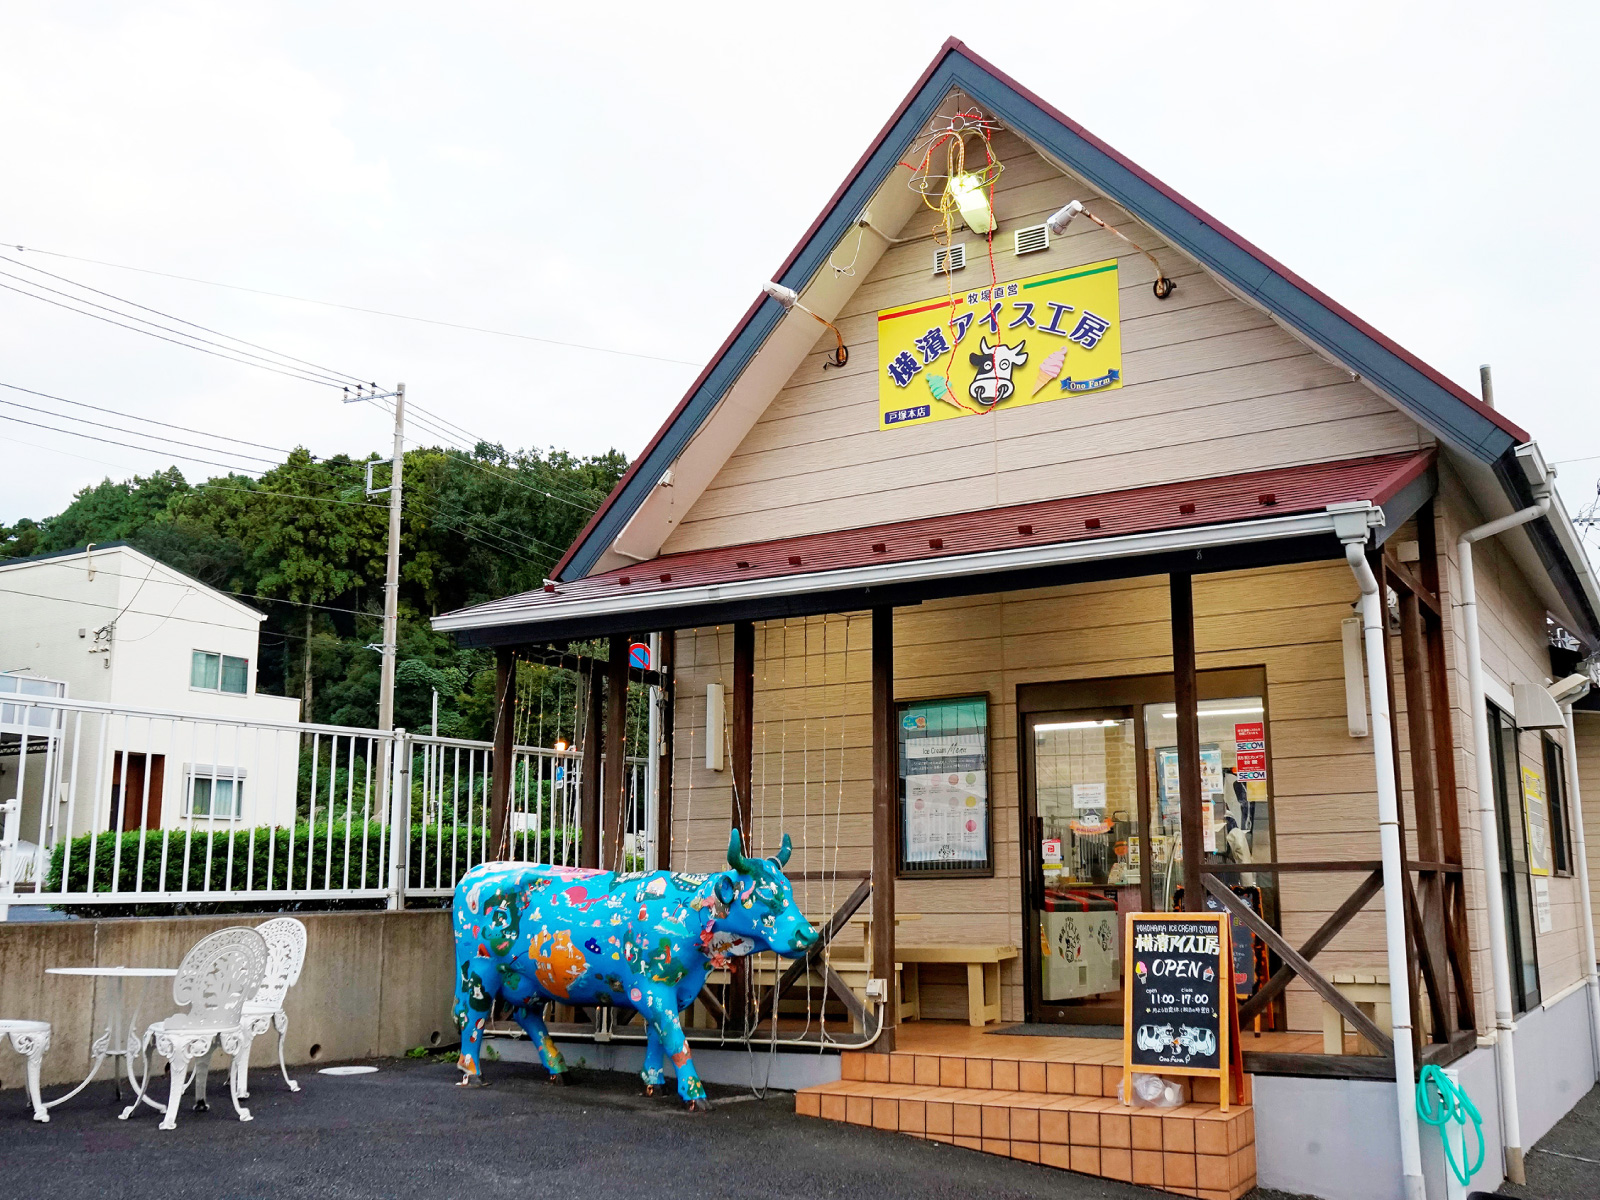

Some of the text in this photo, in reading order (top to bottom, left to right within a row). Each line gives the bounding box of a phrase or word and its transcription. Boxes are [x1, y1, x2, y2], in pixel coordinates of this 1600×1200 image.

[967, 284, 1018, 305] 牧場直営
[887, 302, 1111, 388] 横濱アイス工房
[1089, 377, 1110, 388] Farm
[888, 406, 926, 422] 戸塚本店
[1237, 742, 1263, 750] SECOM
[1136, 924, 1167, 932] YOKOHAMA
[1199, 926, 1218, 934] STUDIO
[1135, 933, 1220, 955] 横濱アイス工房
[1152, 959, 1203, 978] OPEN
